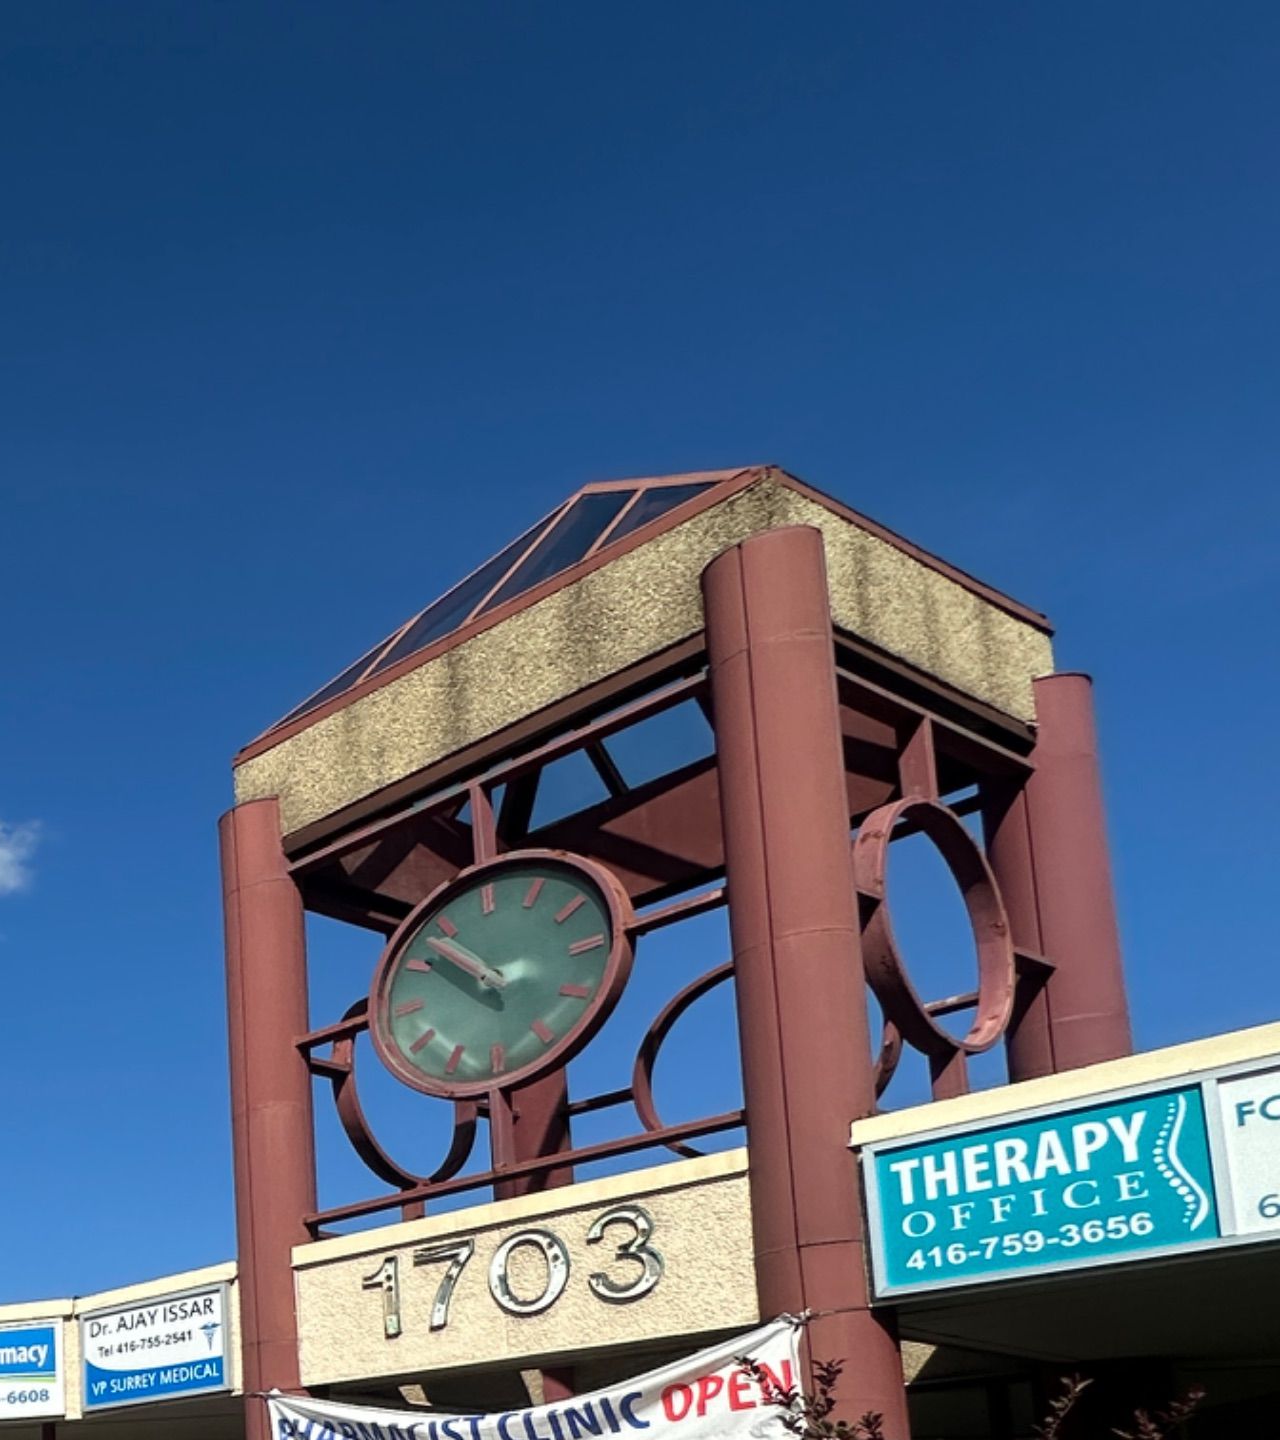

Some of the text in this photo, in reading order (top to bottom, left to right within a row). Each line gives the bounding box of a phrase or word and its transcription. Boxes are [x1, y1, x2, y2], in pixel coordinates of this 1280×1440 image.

[889, 1110, 1148, 1206] THERAPY
[901, 1170, 1150, 1239] OFFICE
[361, 1204, 666, 1340] 1703
[905, 1212, 1155, 1272] 416-759-3656
[90, 1297, 215, 1339] Dr. AJAY ISSAR
[98, 1330, 192, 1358] Tel 416-755-2541
[92, 1362, 220, 1396] VP SURREY MEDICAL
[660, 1359, 793, 1423] OPEN
